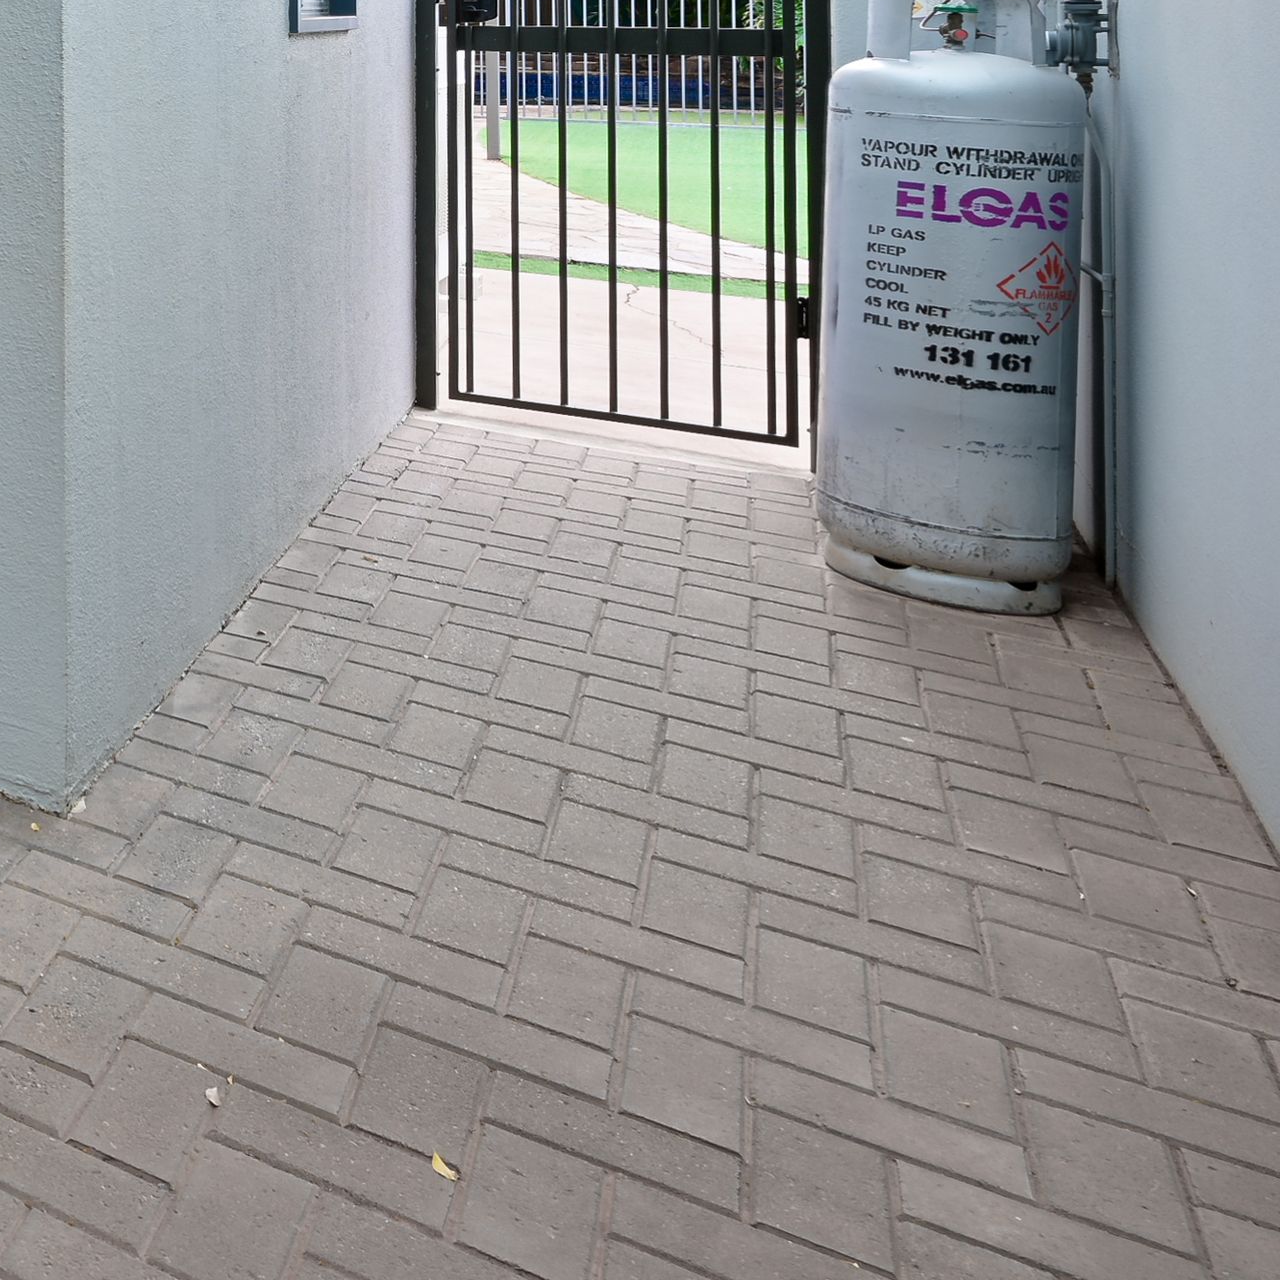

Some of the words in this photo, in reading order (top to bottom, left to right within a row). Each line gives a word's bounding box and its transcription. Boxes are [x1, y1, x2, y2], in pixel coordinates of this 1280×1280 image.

[862, 138, 938, 158] VAPOUR
[946, 146, 1068, 167] WITHDRAWAL
[861, 153, 921, 172] STAND
[935, 161, 1040, 181] CYLINDER
[896, 181, 1070, 231] ELGAS
[868, 224, 886, 235] LP
[891, 227, 926, 241] GAS
[867, 242, 906, 256] KEEP
[866, 260, 947, 280] CYLINDER
[865, 277, 909, 294] COOL
[864, 295, 882, 307] 45
[886, 299, 910, 312] KG
[915, 303, 952, 318] NET
[863, 312, 893, 328] FILL
[898, 319, 920, 332] BY
[925, 323, 996, 343] WEIGHT
[999, 332, 1041, 346] ONLY
[924, 344, 975, 368] 131
[987, 352, 1033, 373] 161
[893, 366, 1056, 396] www.elgas.com.au
